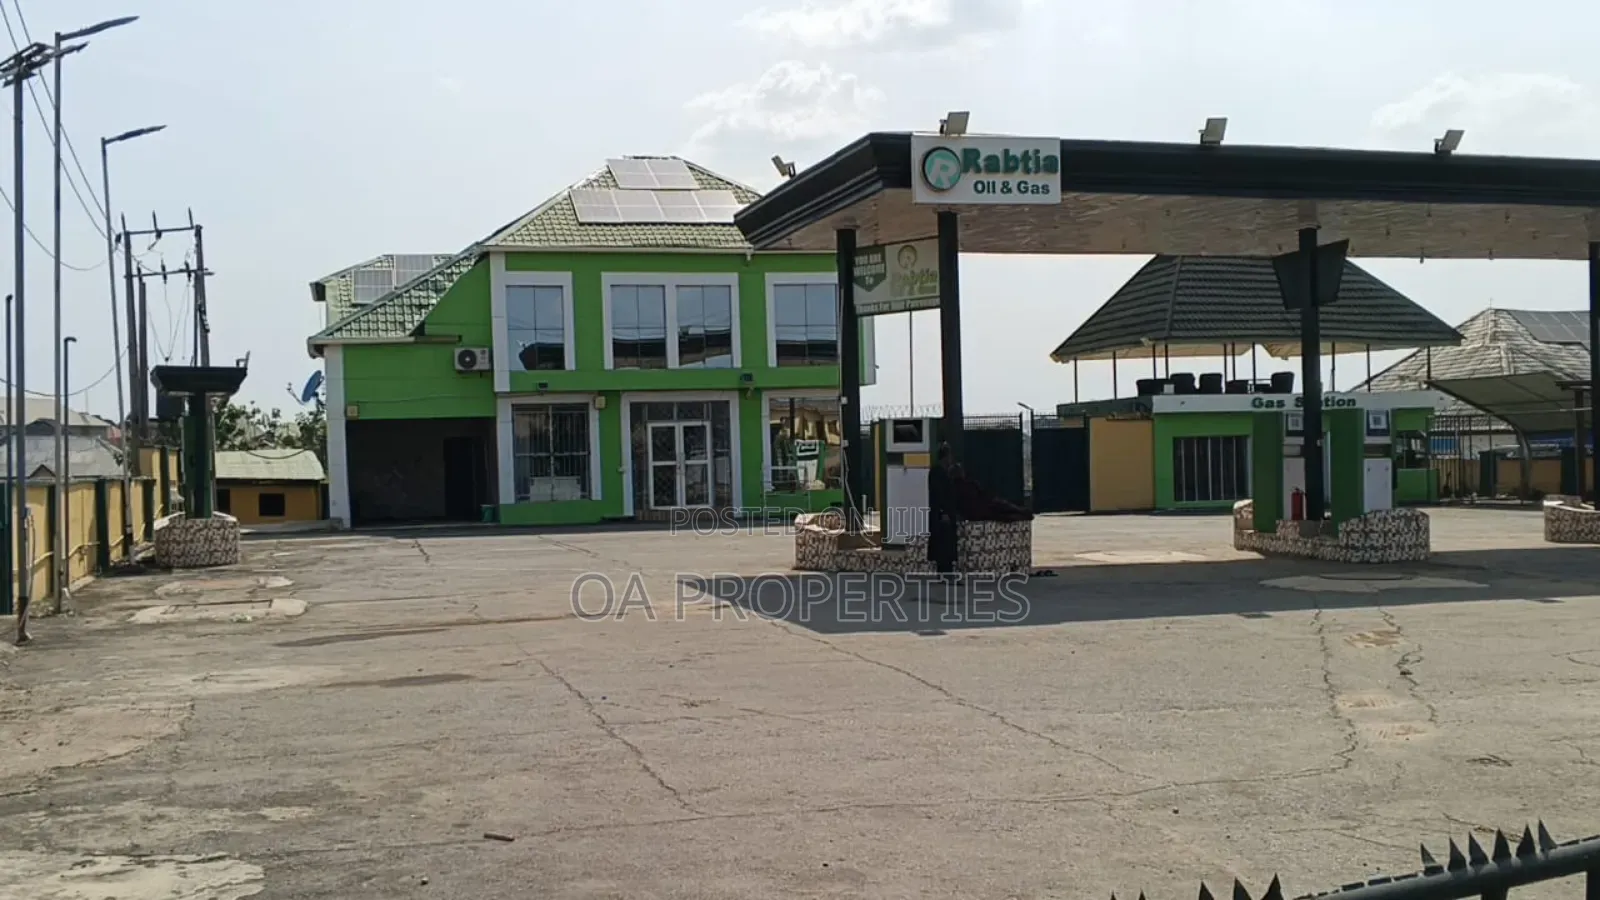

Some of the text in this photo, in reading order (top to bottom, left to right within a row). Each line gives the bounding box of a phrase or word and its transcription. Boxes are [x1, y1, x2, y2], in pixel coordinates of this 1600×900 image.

[962, 147, 1060, 175] Rabtia
[1000, 180, 1013, 194] &
[1017, 180, 1051, 195] Gas
[1251, 395, 1357, 409] Gas Stion
